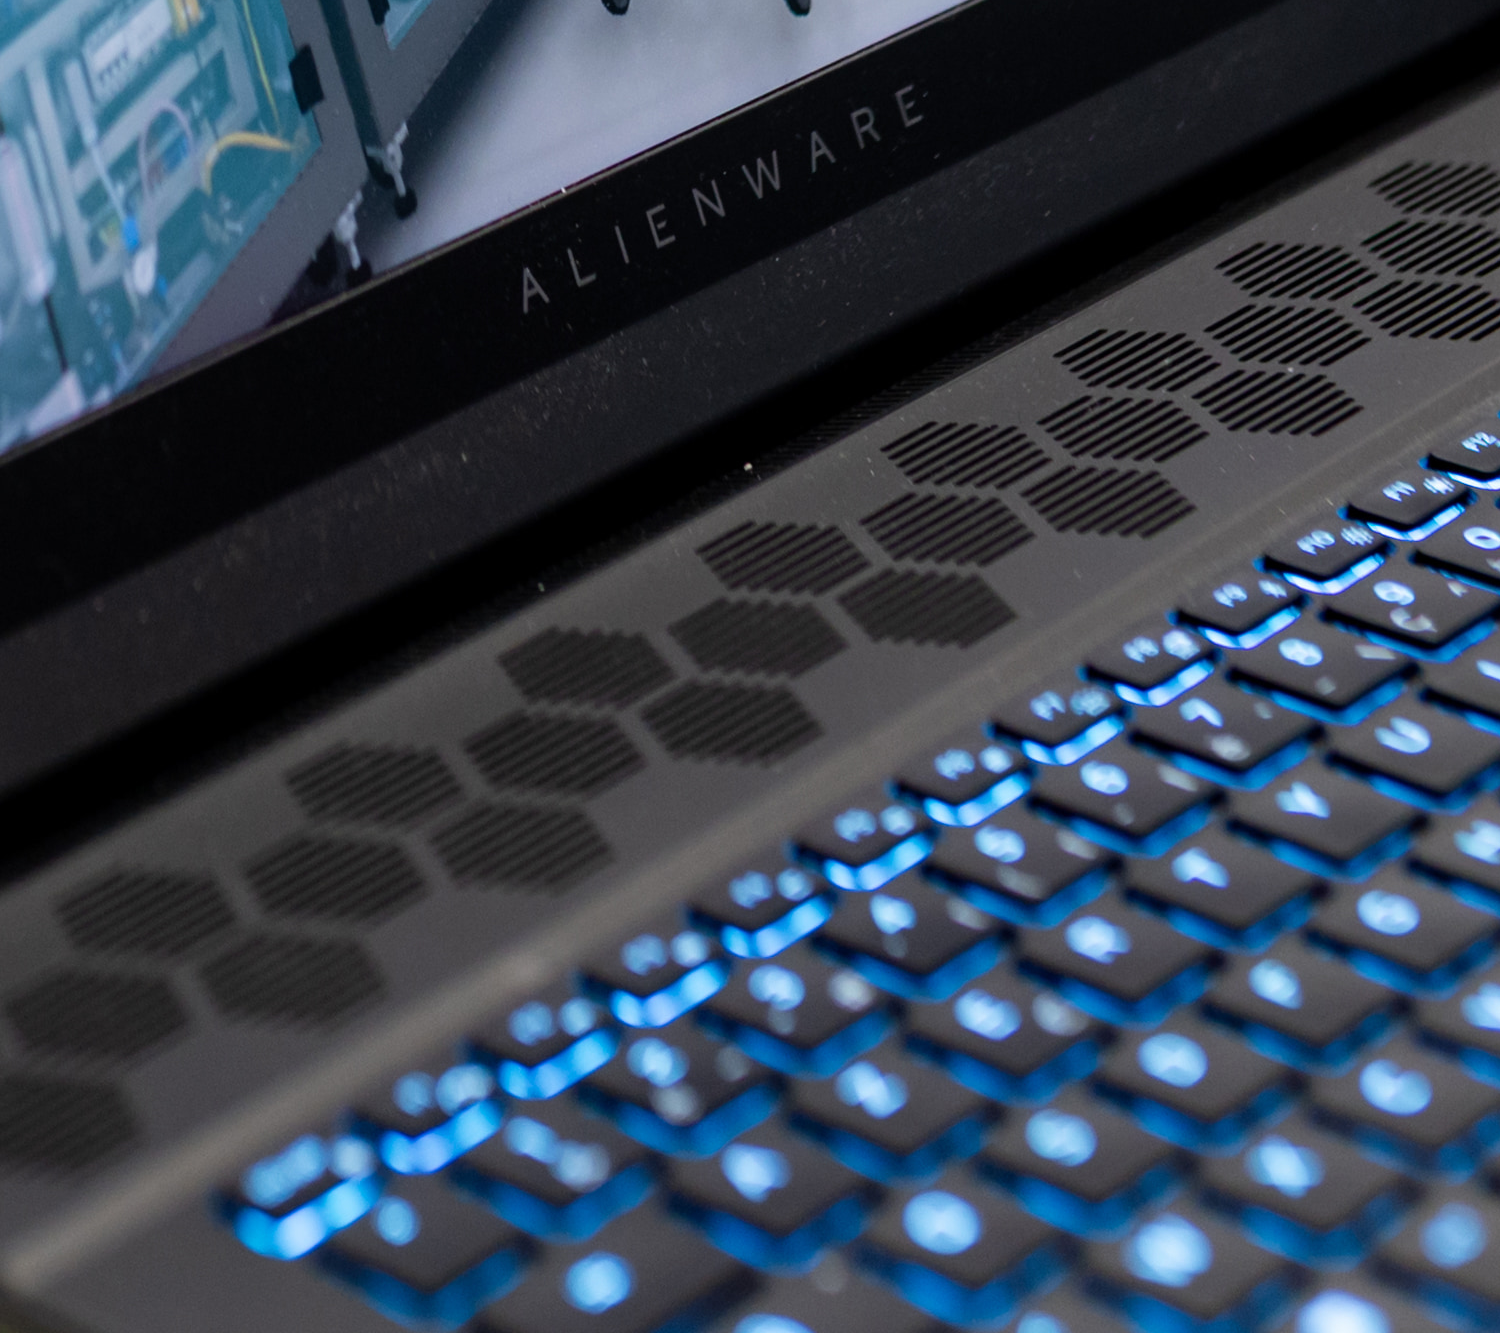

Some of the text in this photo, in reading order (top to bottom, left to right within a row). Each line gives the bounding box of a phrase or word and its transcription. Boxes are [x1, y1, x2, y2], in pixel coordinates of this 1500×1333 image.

[520, 84, 924, 315] ALIENWARE
[1462, 432, 1498, 453] F12
[1376, 717, 1431, 754] U
[1277, 782, 1329, 818] Y
